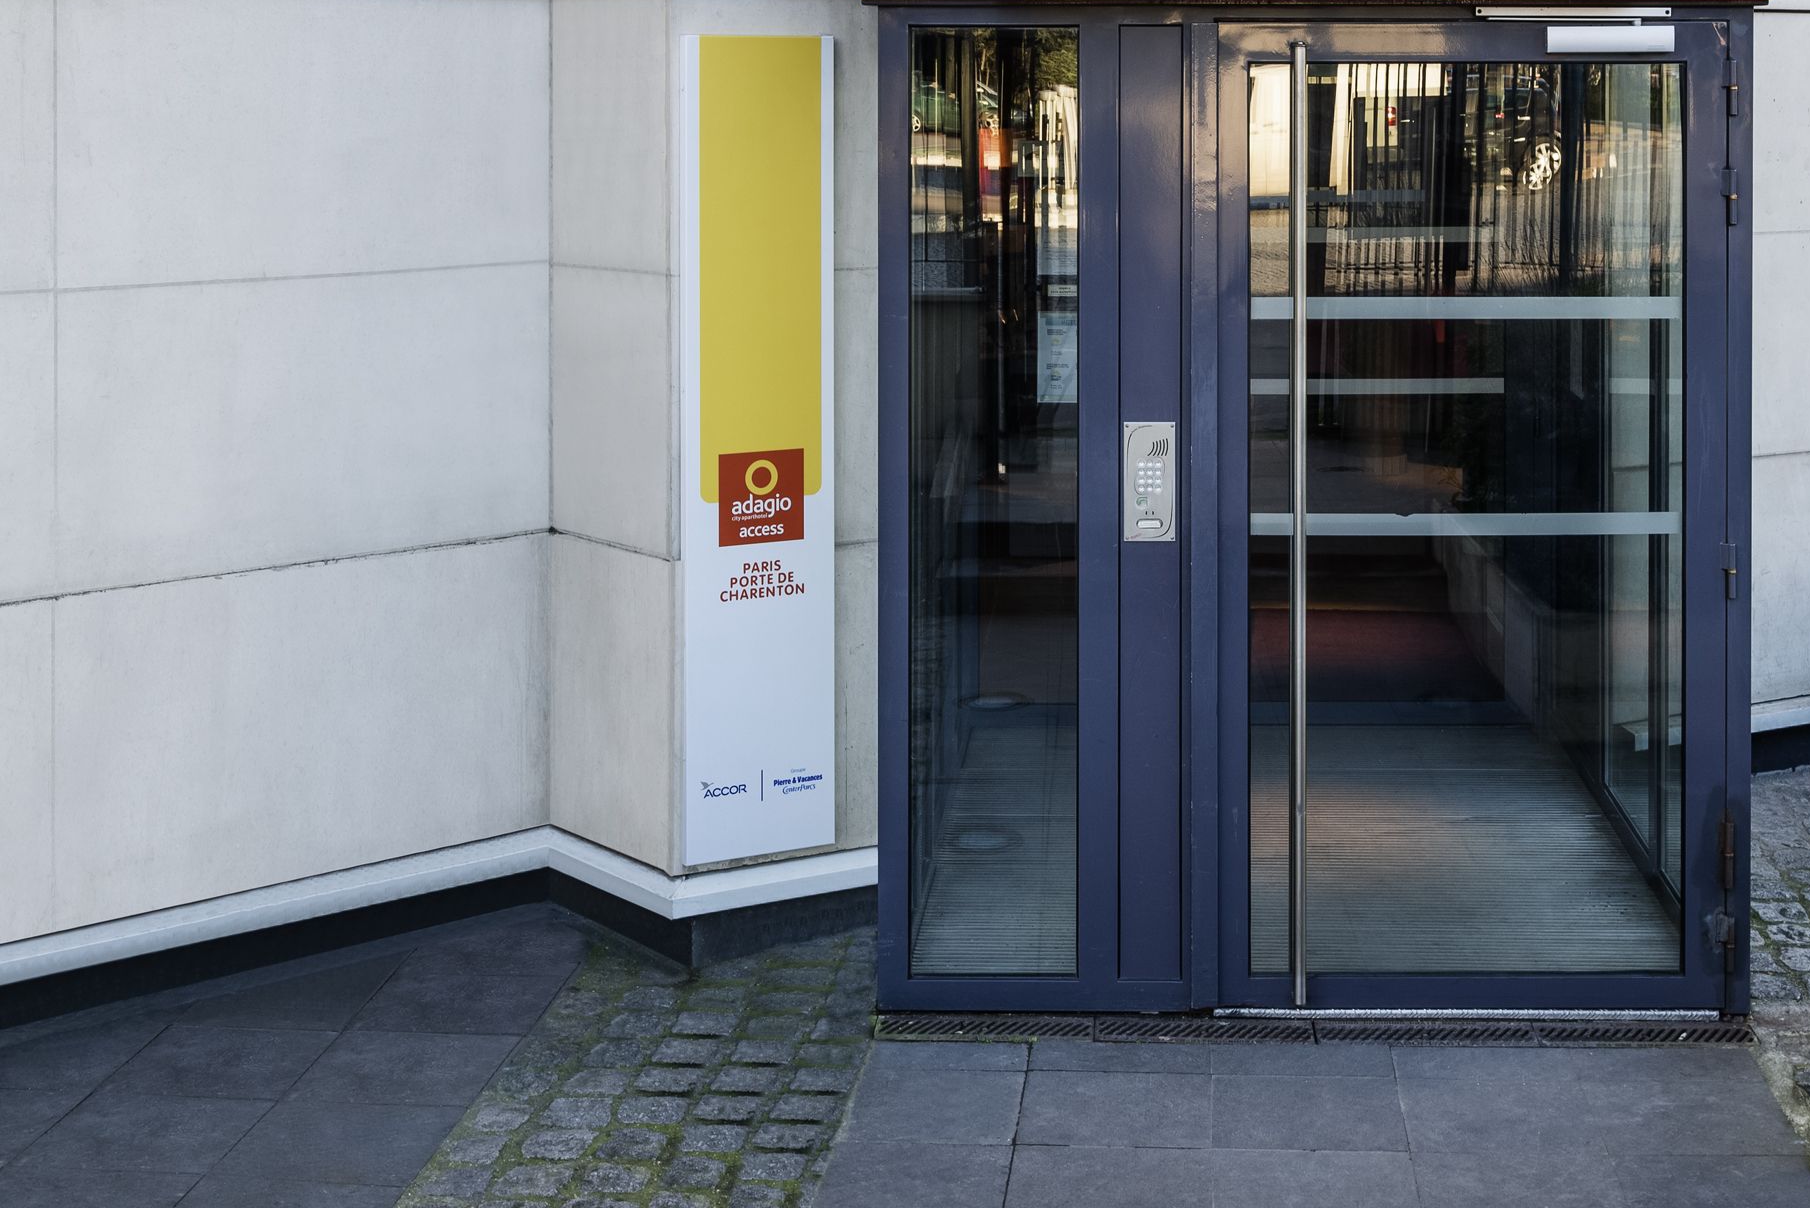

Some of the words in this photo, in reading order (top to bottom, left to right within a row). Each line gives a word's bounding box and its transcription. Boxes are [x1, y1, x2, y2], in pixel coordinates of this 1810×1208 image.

[731, 493, 792, 518] adagio
[739, 523, 784, 538] access
[743, 560, 781, 574] PARIS
[730, 574, 774, 589] PORTE
[777, 572, 794, 583] DE
[720, 583, 805, 603] CHARENTON
[773, 778, 791, 787] Pierre
[798, 773, 823, 783] Vacances
[703, 784, 747, 799] ACCOR
